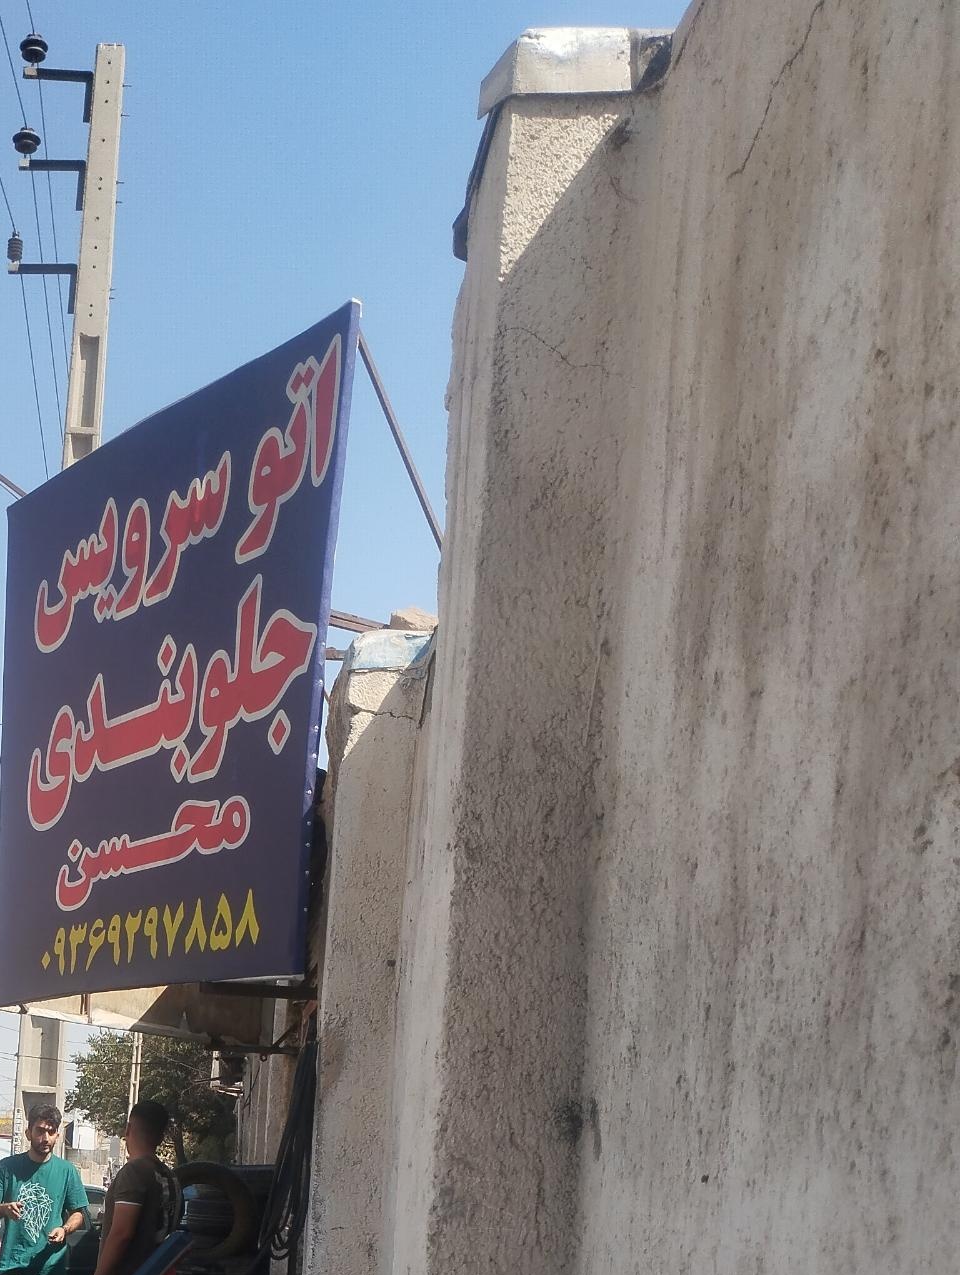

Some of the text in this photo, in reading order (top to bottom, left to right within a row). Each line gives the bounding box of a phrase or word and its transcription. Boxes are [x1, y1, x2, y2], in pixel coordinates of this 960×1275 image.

[34, 334, 341, 653] اتو سرویس
[28, 574, 317, 831] جلوبندی
[41, 889, 260, 976] ۰۹۳۶۹۲۹۷۸۵۸
[55, 796, 250, 911] محسن
